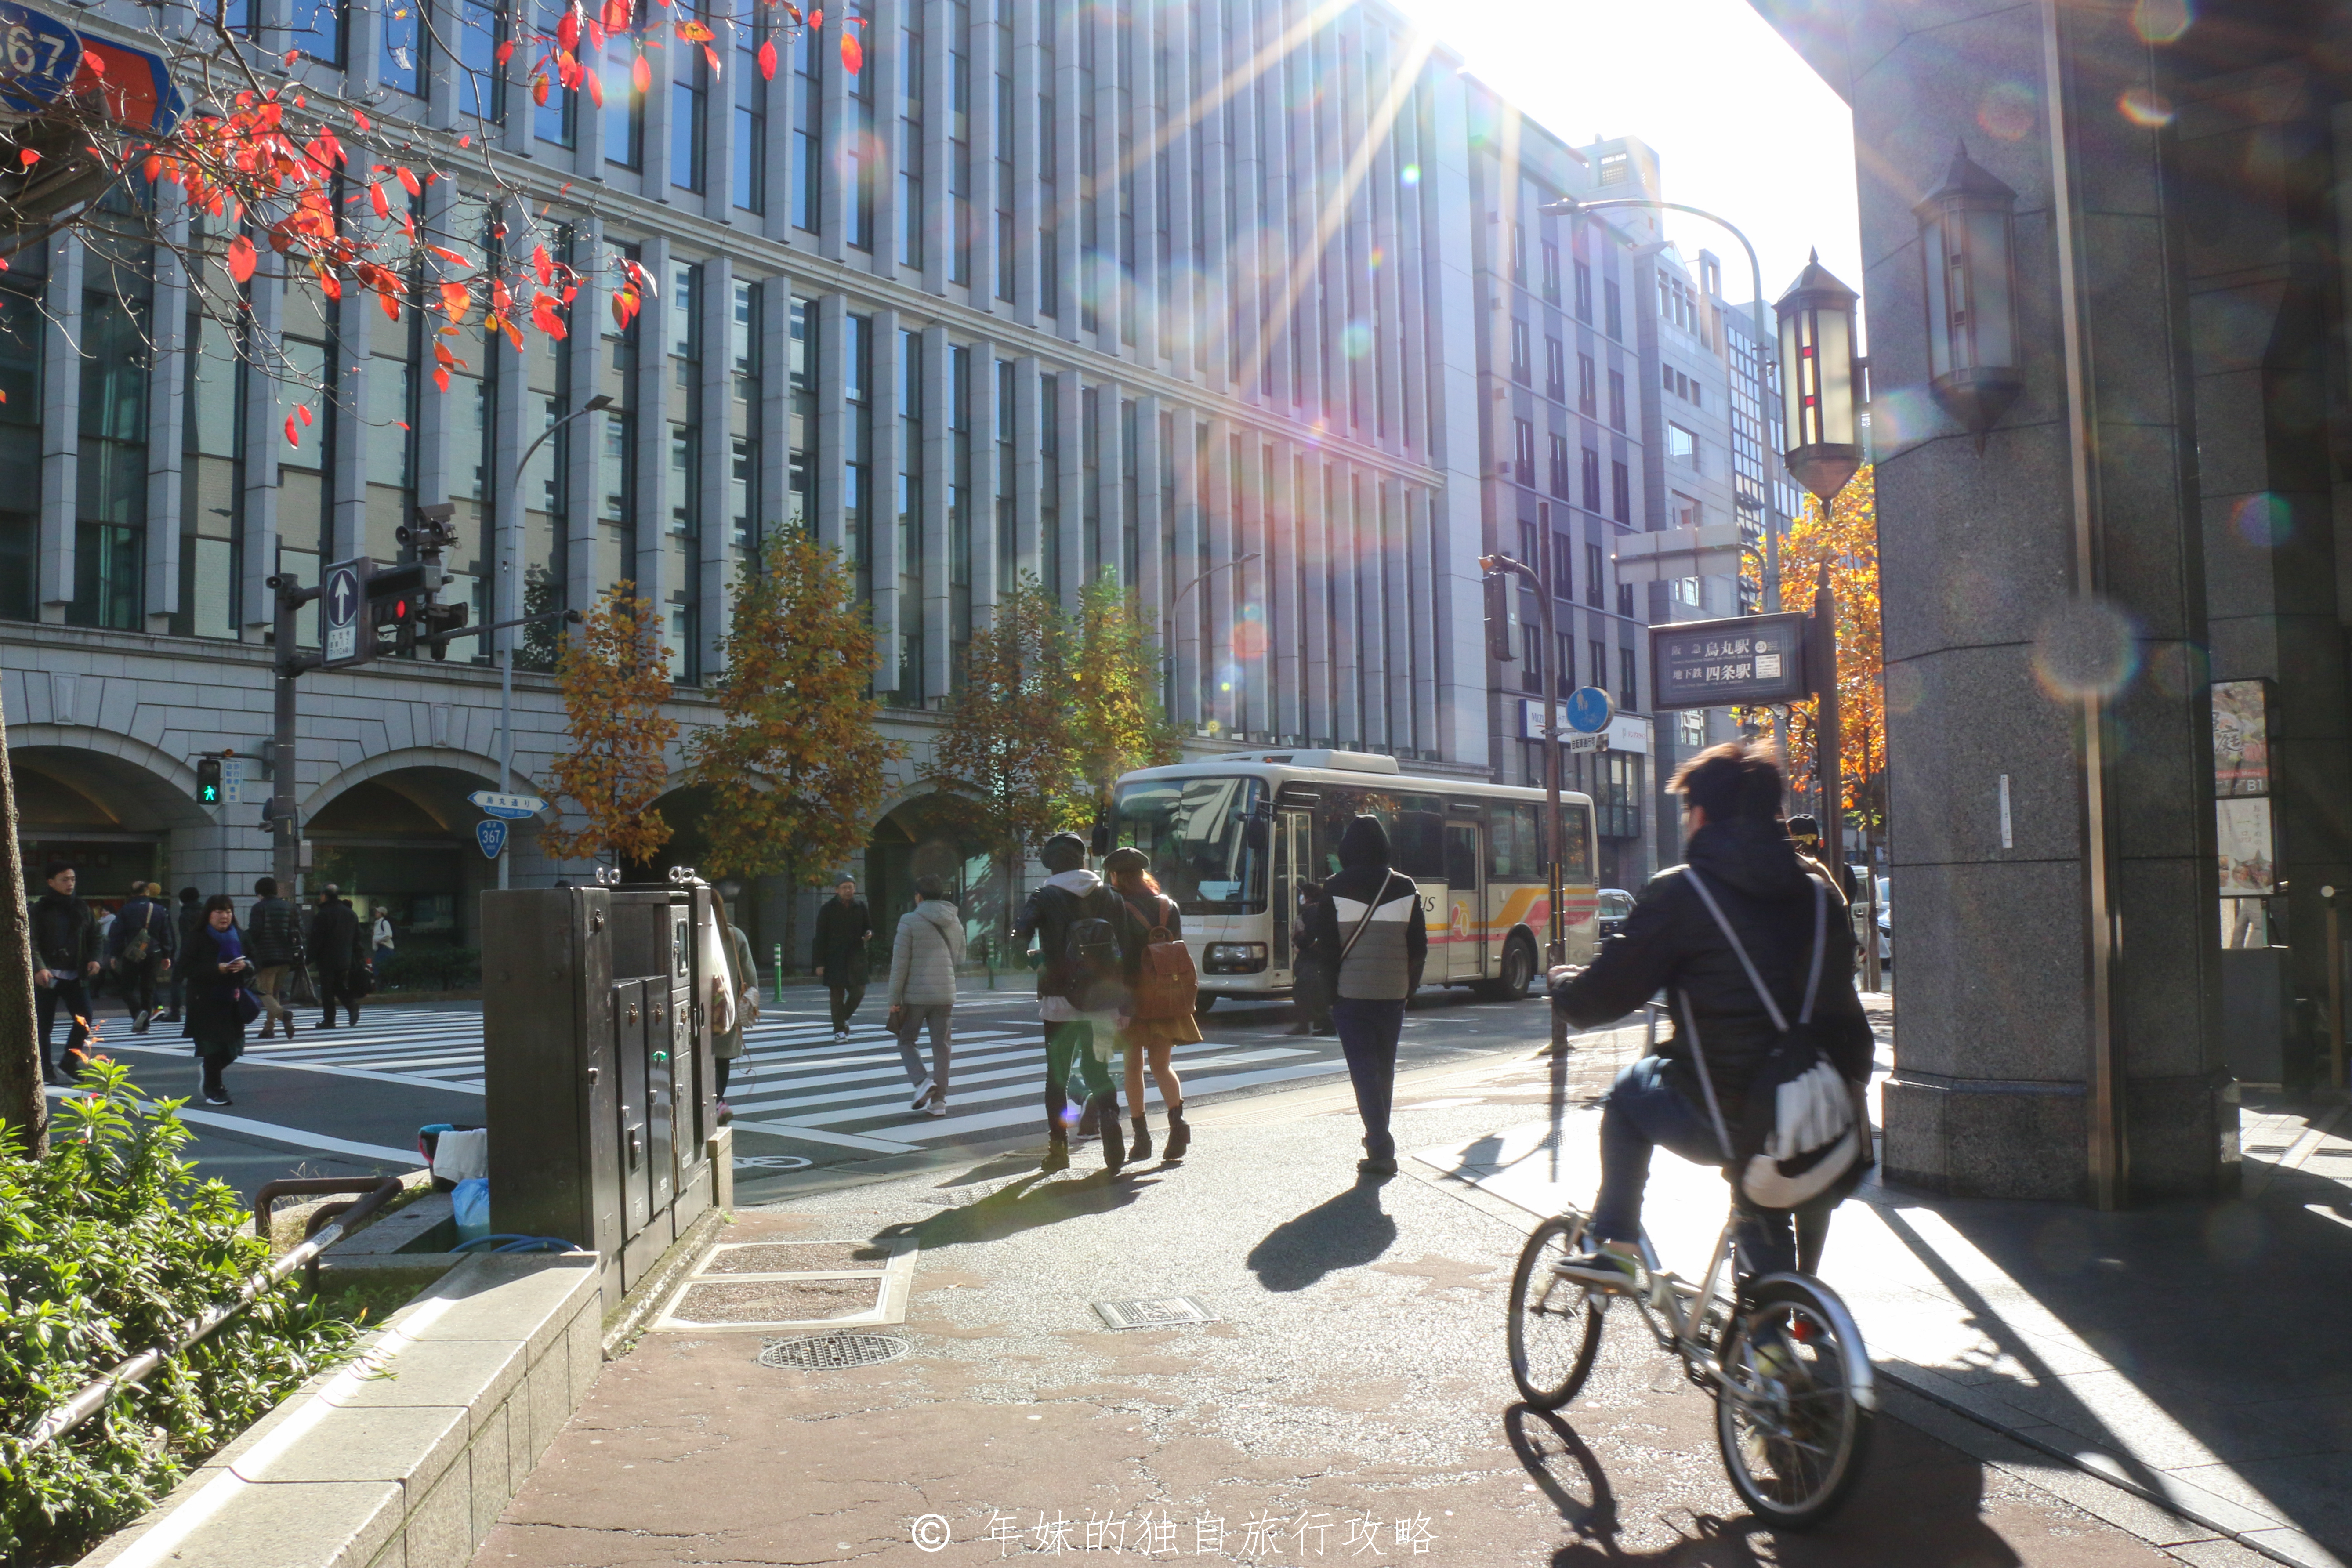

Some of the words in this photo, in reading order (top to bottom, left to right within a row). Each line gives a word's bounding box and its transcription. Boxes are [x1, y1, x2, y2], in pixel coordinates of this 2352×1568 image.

[0, 25, 65, 81] 67
[1673, 667, 1702, 680] 地下鉄
[1706, 663, 1751, 681] 四条駅
[1531, 712, 1545, 723] MIZU
[1572, 737, 1595, 749] 自転車通行可
[2247, 779, 2263, 791] B1
[482, 829, 501, 844] 367
